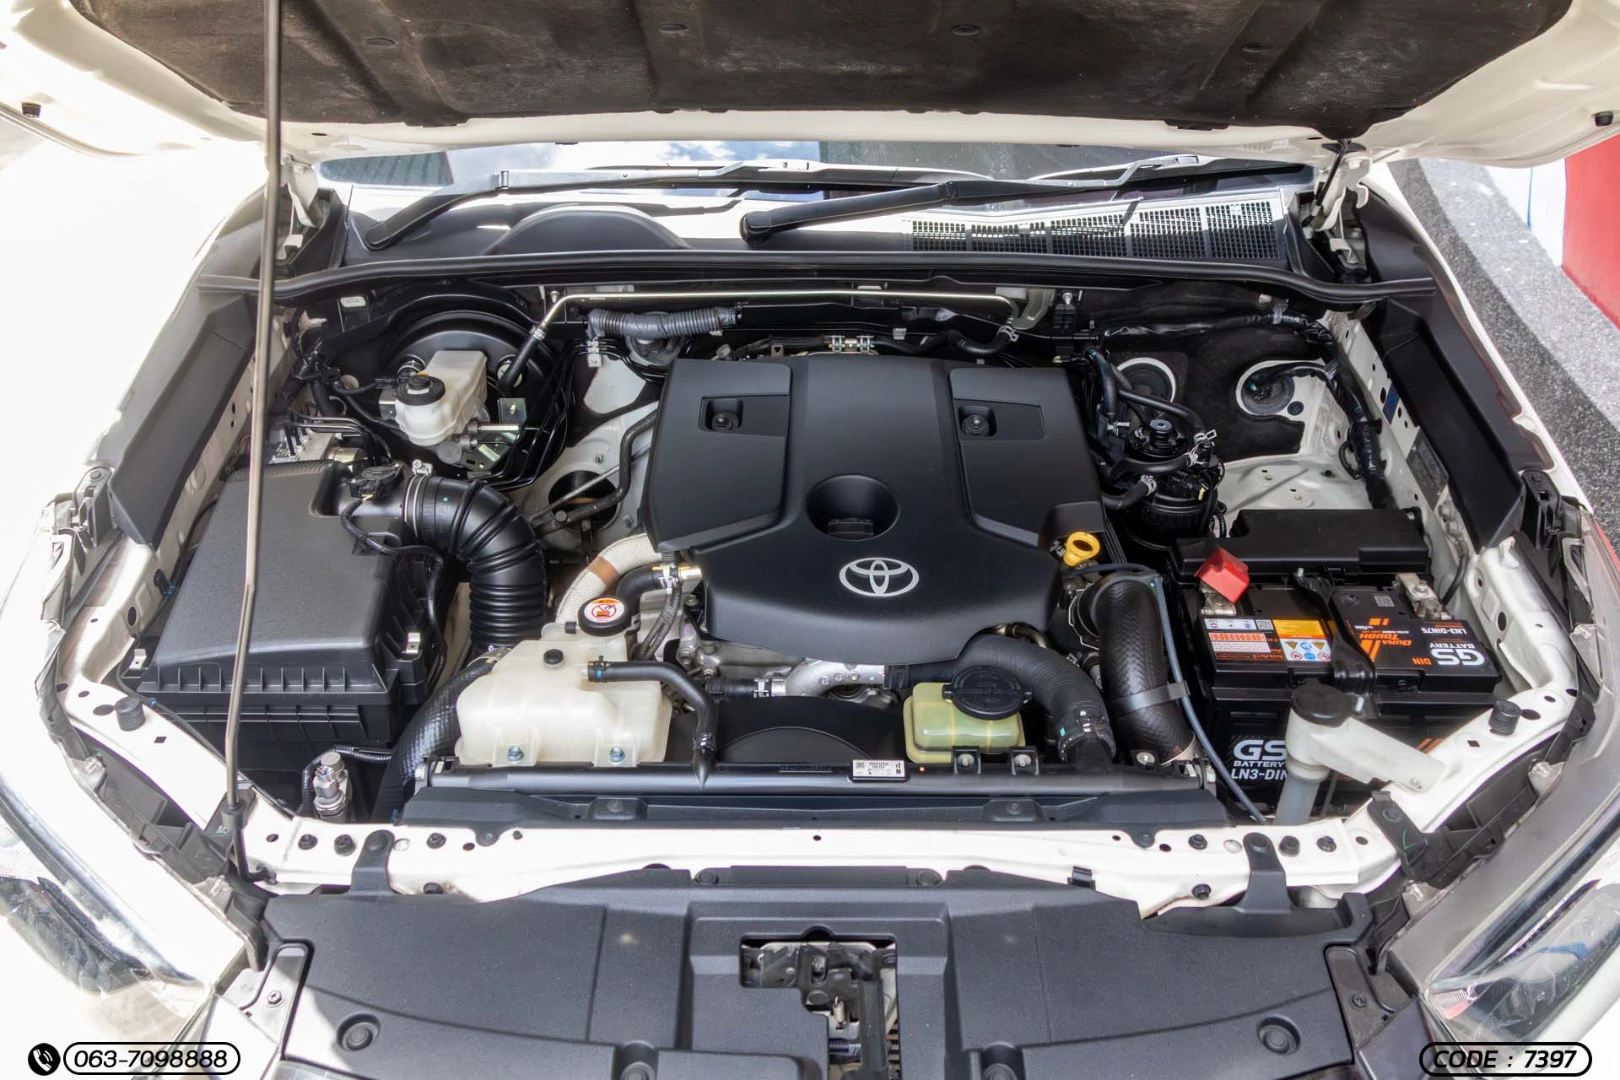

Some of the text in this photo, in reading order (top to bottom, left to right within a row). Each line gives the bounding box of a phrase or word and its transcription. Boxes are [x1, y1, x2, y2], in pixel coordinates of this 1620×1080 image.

[1421, 627, 1467, 635] LN3-DIN75
[1412, 657, 1432, 666] DIN
[1430, 648, 1485, 666] GS
[1233, 739, 1287, 761] GS
[1233, 760, 1285, 768] BATTERY
